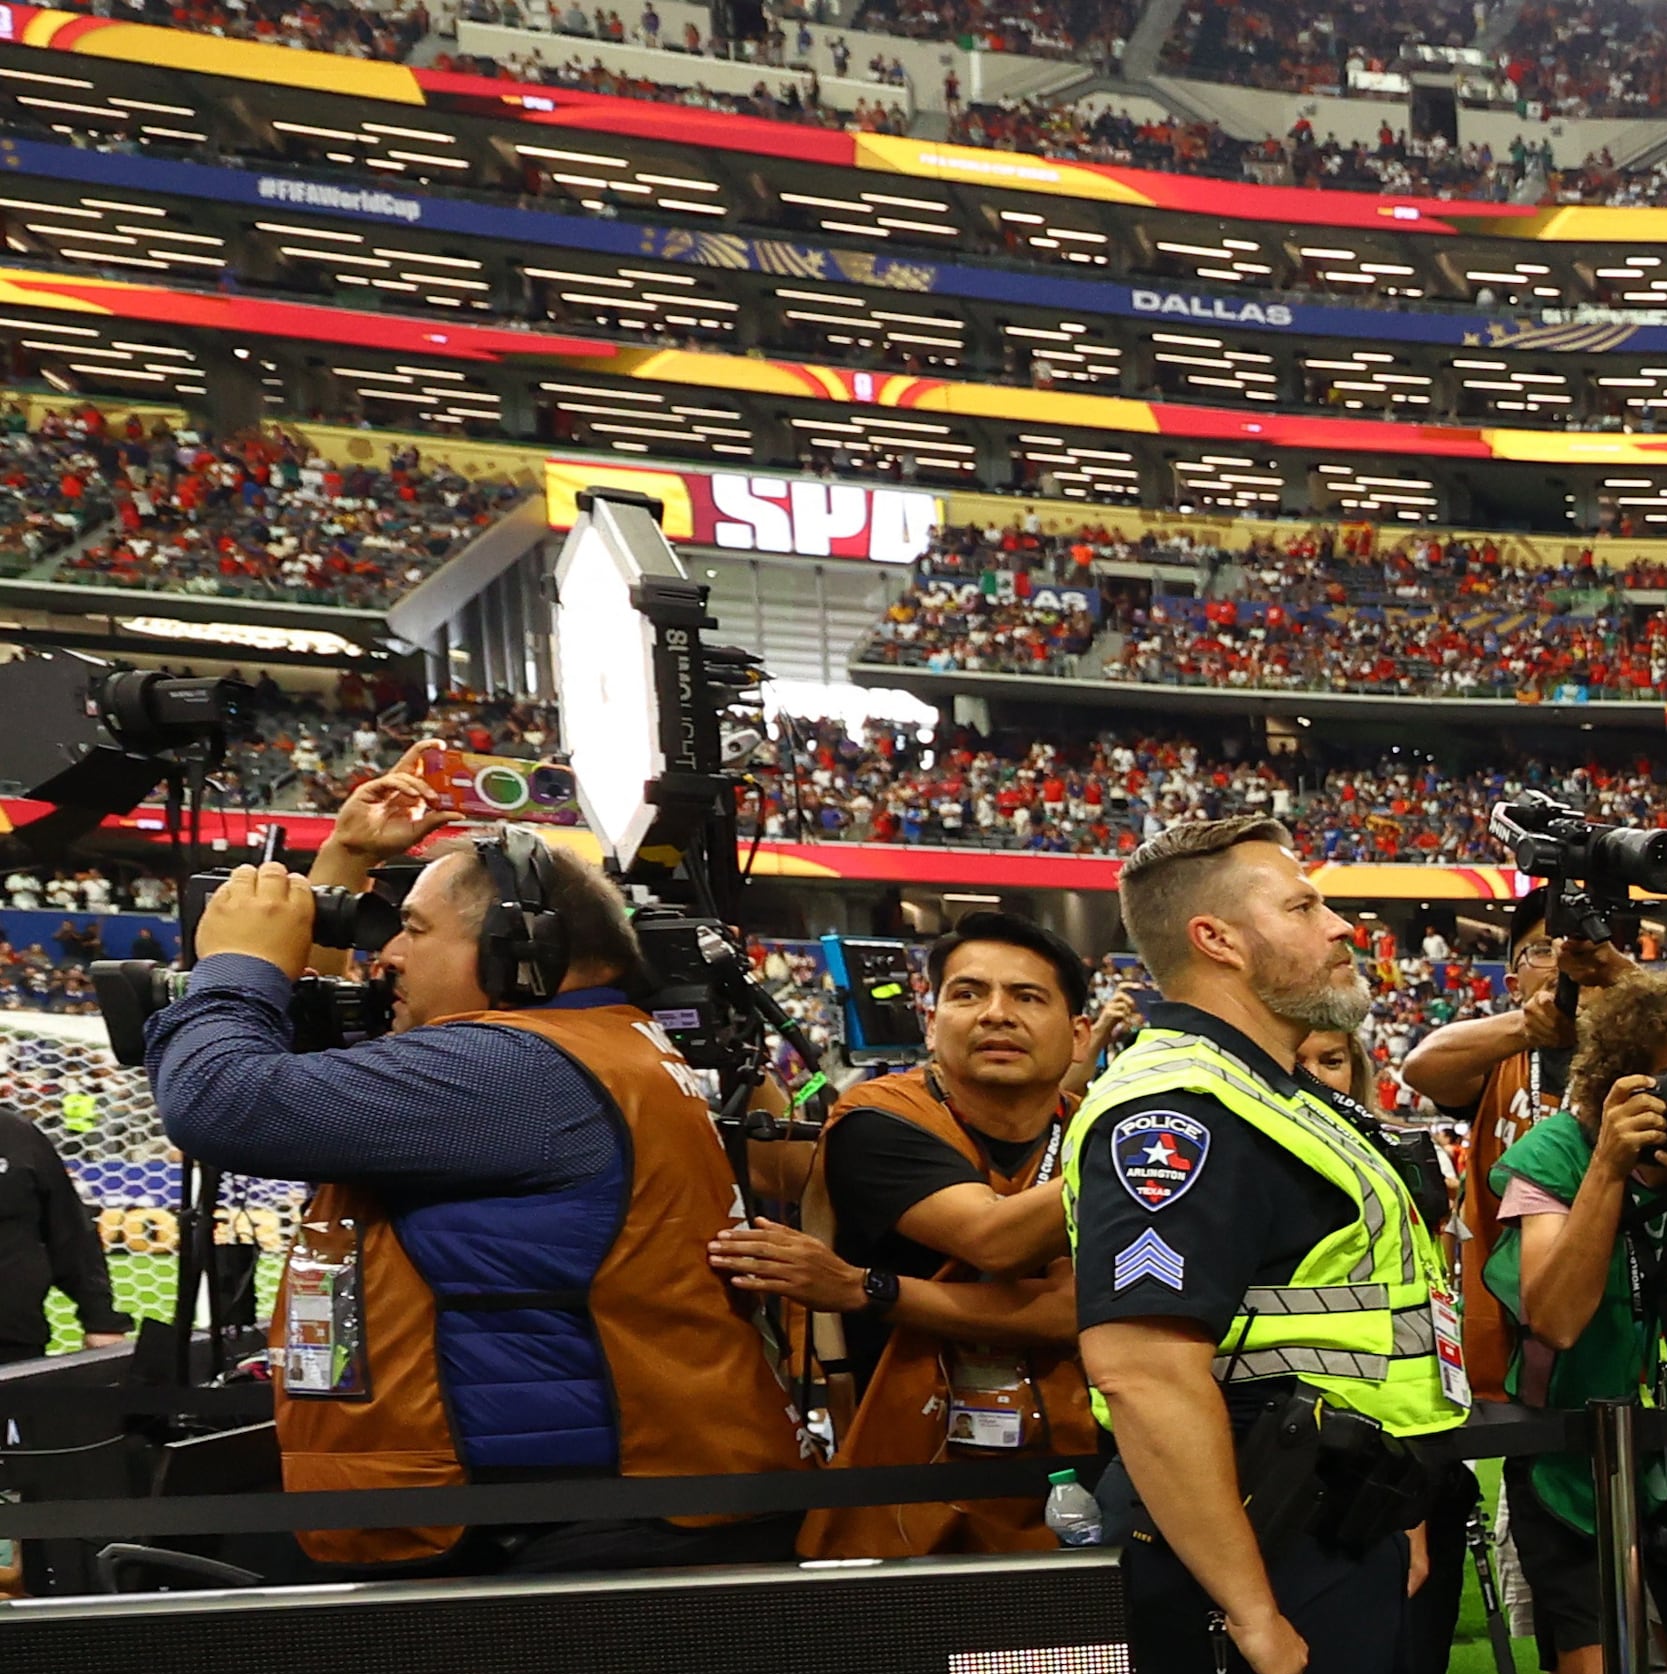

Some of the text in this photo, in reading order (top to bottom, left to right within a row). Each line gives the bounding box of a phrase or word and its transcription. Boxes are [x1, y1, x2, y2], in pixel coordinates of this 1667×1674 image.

[258, 177, 420, 220] #FIFAWorldCup
[1132, 289, 1293, 326] DALLAS
[1119, 1114, 1203, 1141] POLICE
[1126, 1167, 1187, 1182] ARLINGTON
[1136, 1186, 1172, 1197] TEXAS
